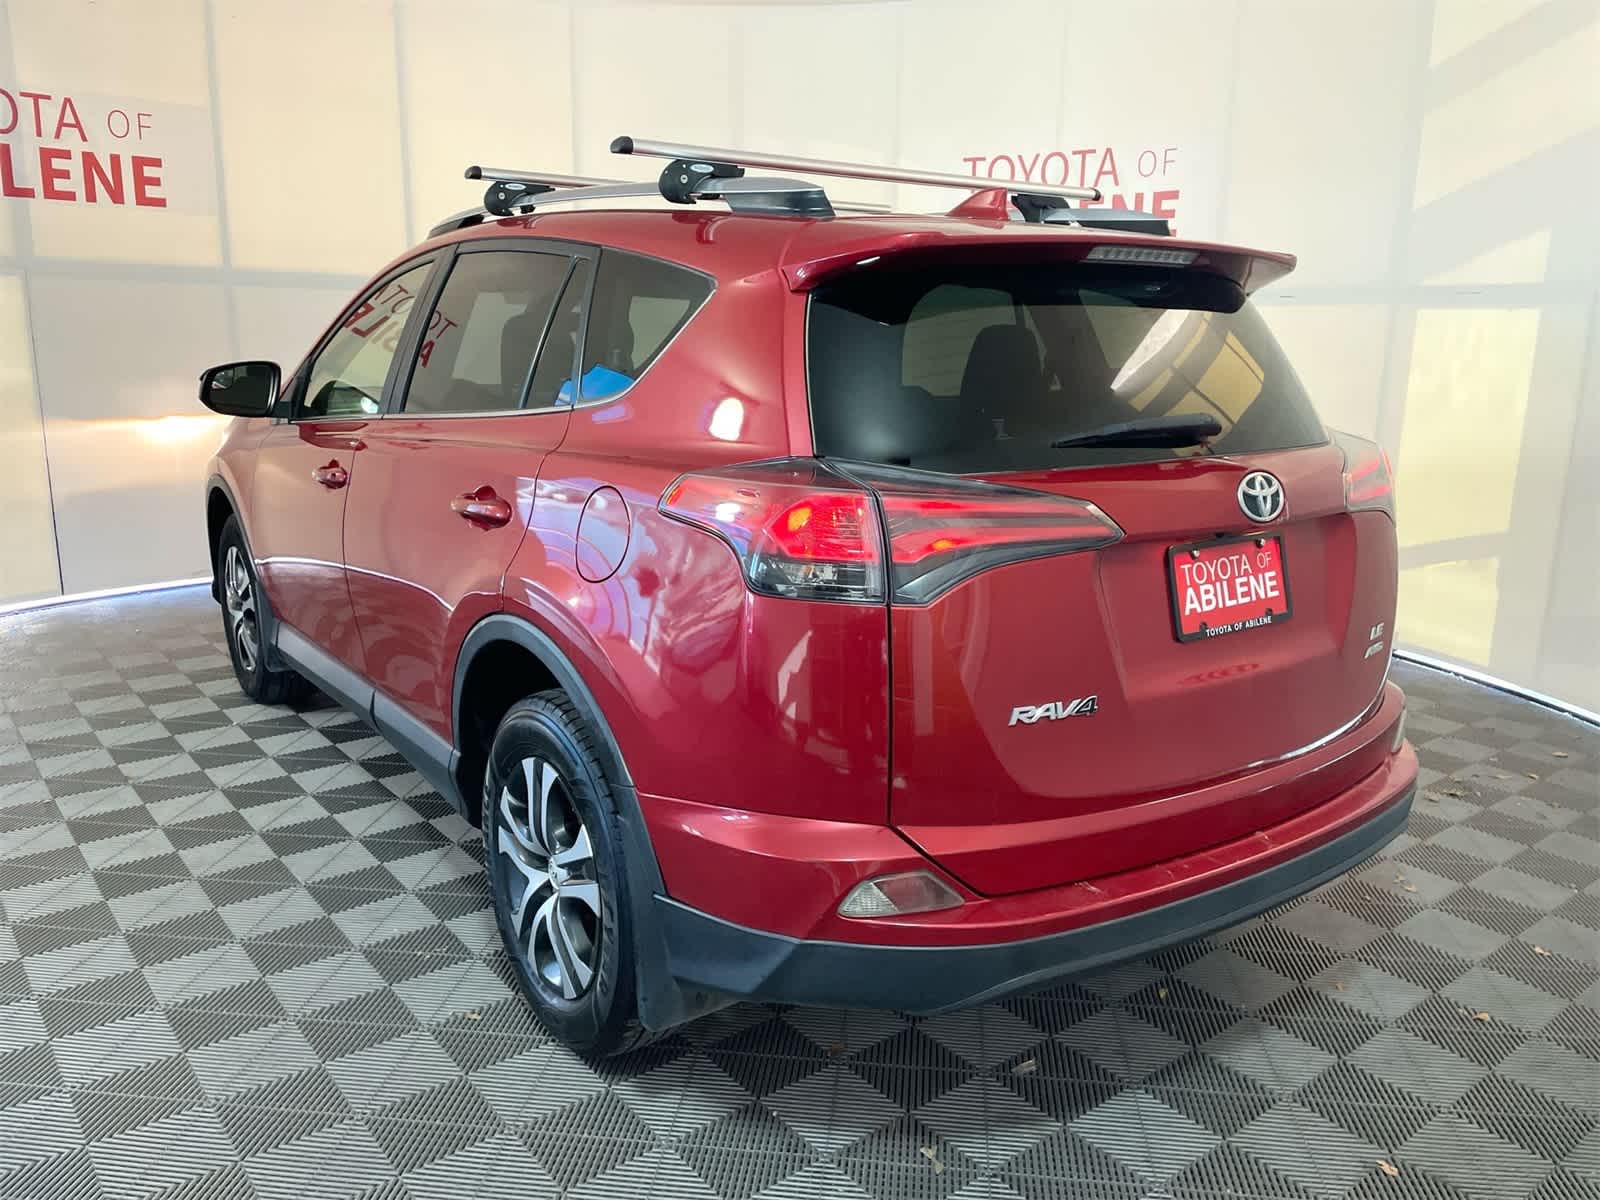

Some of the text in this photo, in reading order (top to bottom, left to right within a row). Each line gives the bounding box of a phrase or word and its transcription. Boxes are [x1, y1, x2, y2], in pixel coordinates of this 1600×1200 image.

[107, 109, 153, 140] OF
[1137, 147, 1178, 177] OF
[1180, 551, 1272, 586] TOYOTA OF
[1184, 570, 1280, 616] ABILENE
[1206, 615, 1272, 637] TOYOTA OF ABILENE
[1007, 695, 1098, 727] RAV4
